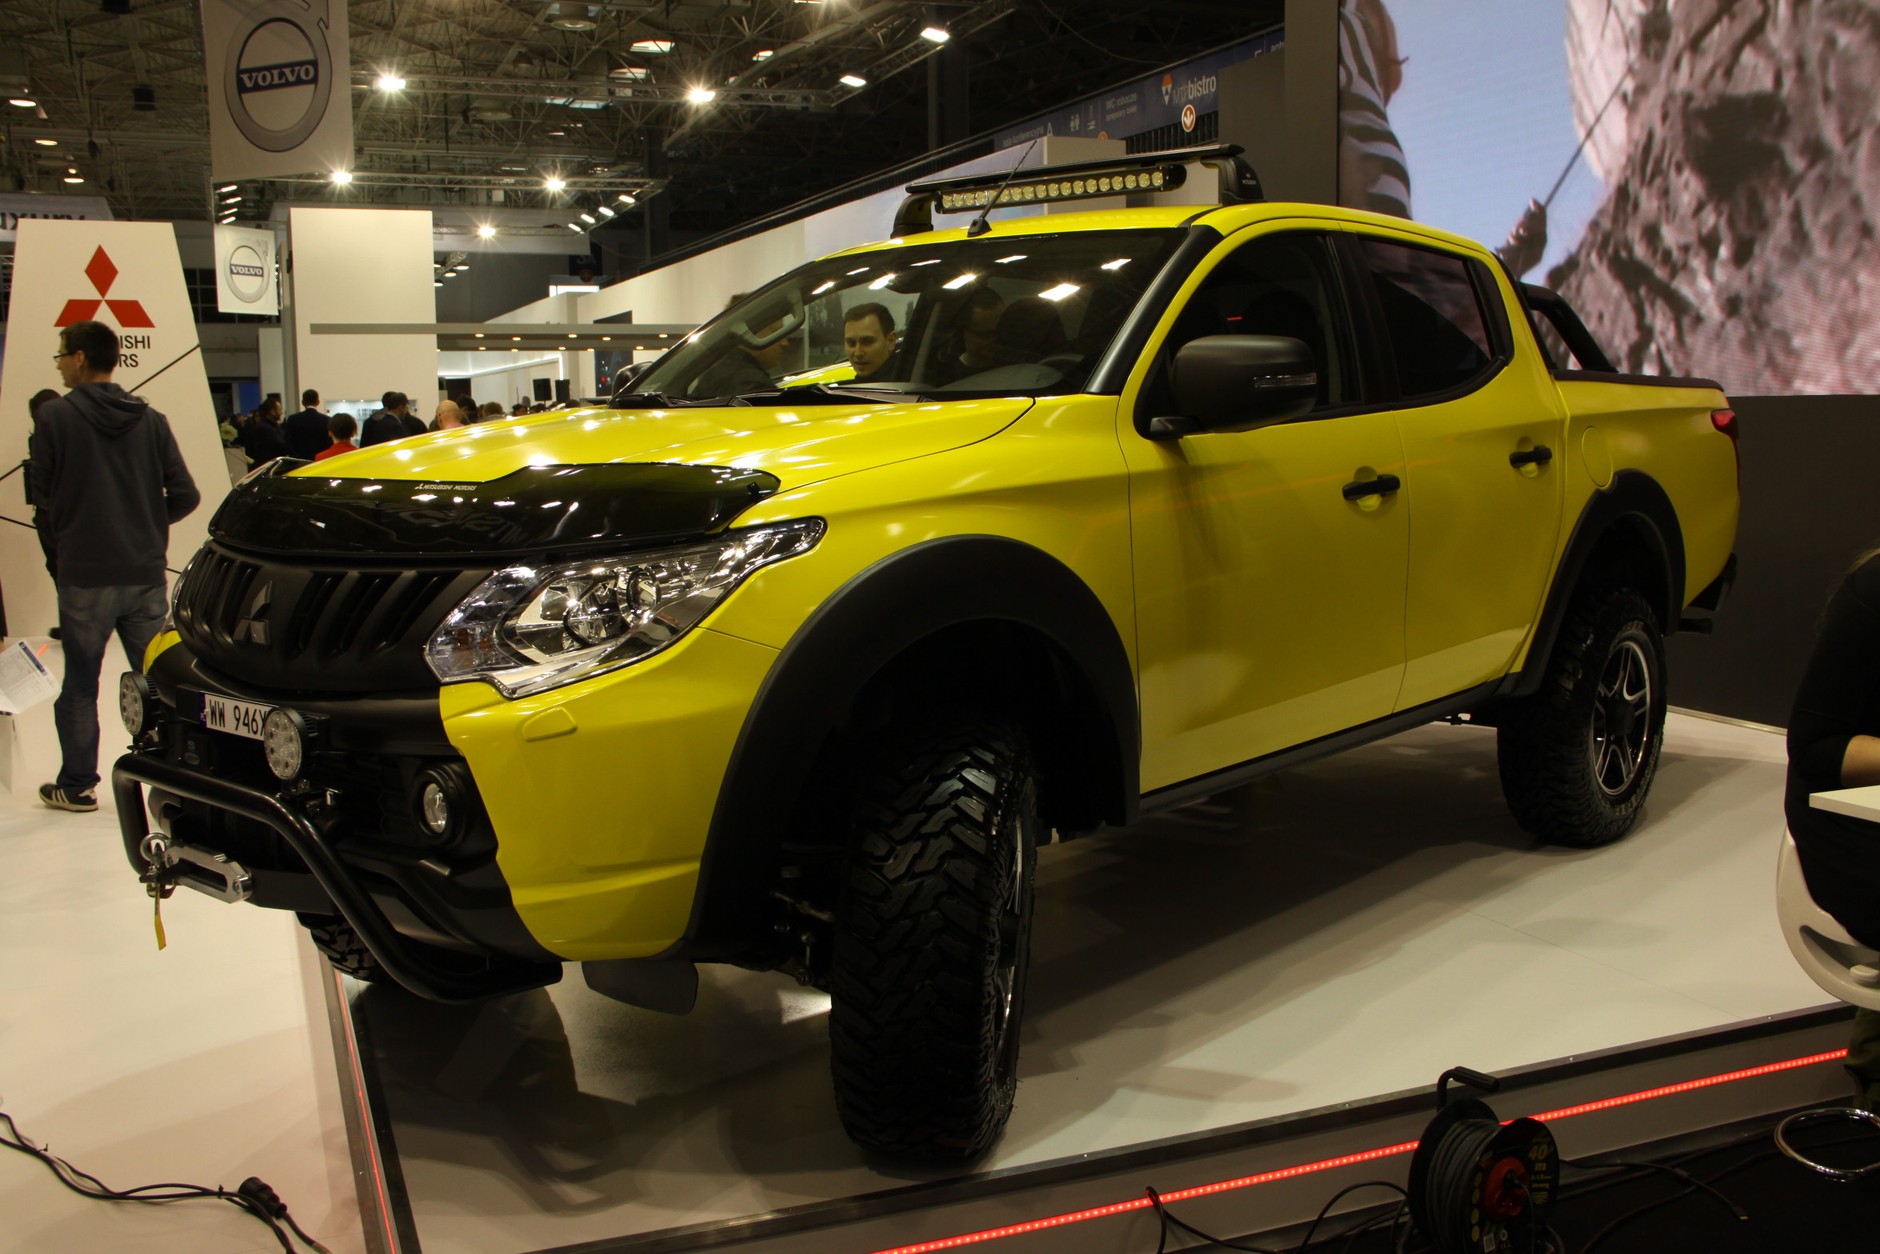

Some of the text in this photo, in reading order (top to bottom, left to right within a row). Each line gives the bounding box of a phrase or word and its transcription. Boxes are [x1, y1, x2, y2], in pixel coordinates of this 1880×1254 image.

[240, 64, 315, 88] VOLVO
[231, 266, 263, 276] VOLVO
[209, 699, 225, 728] WW
